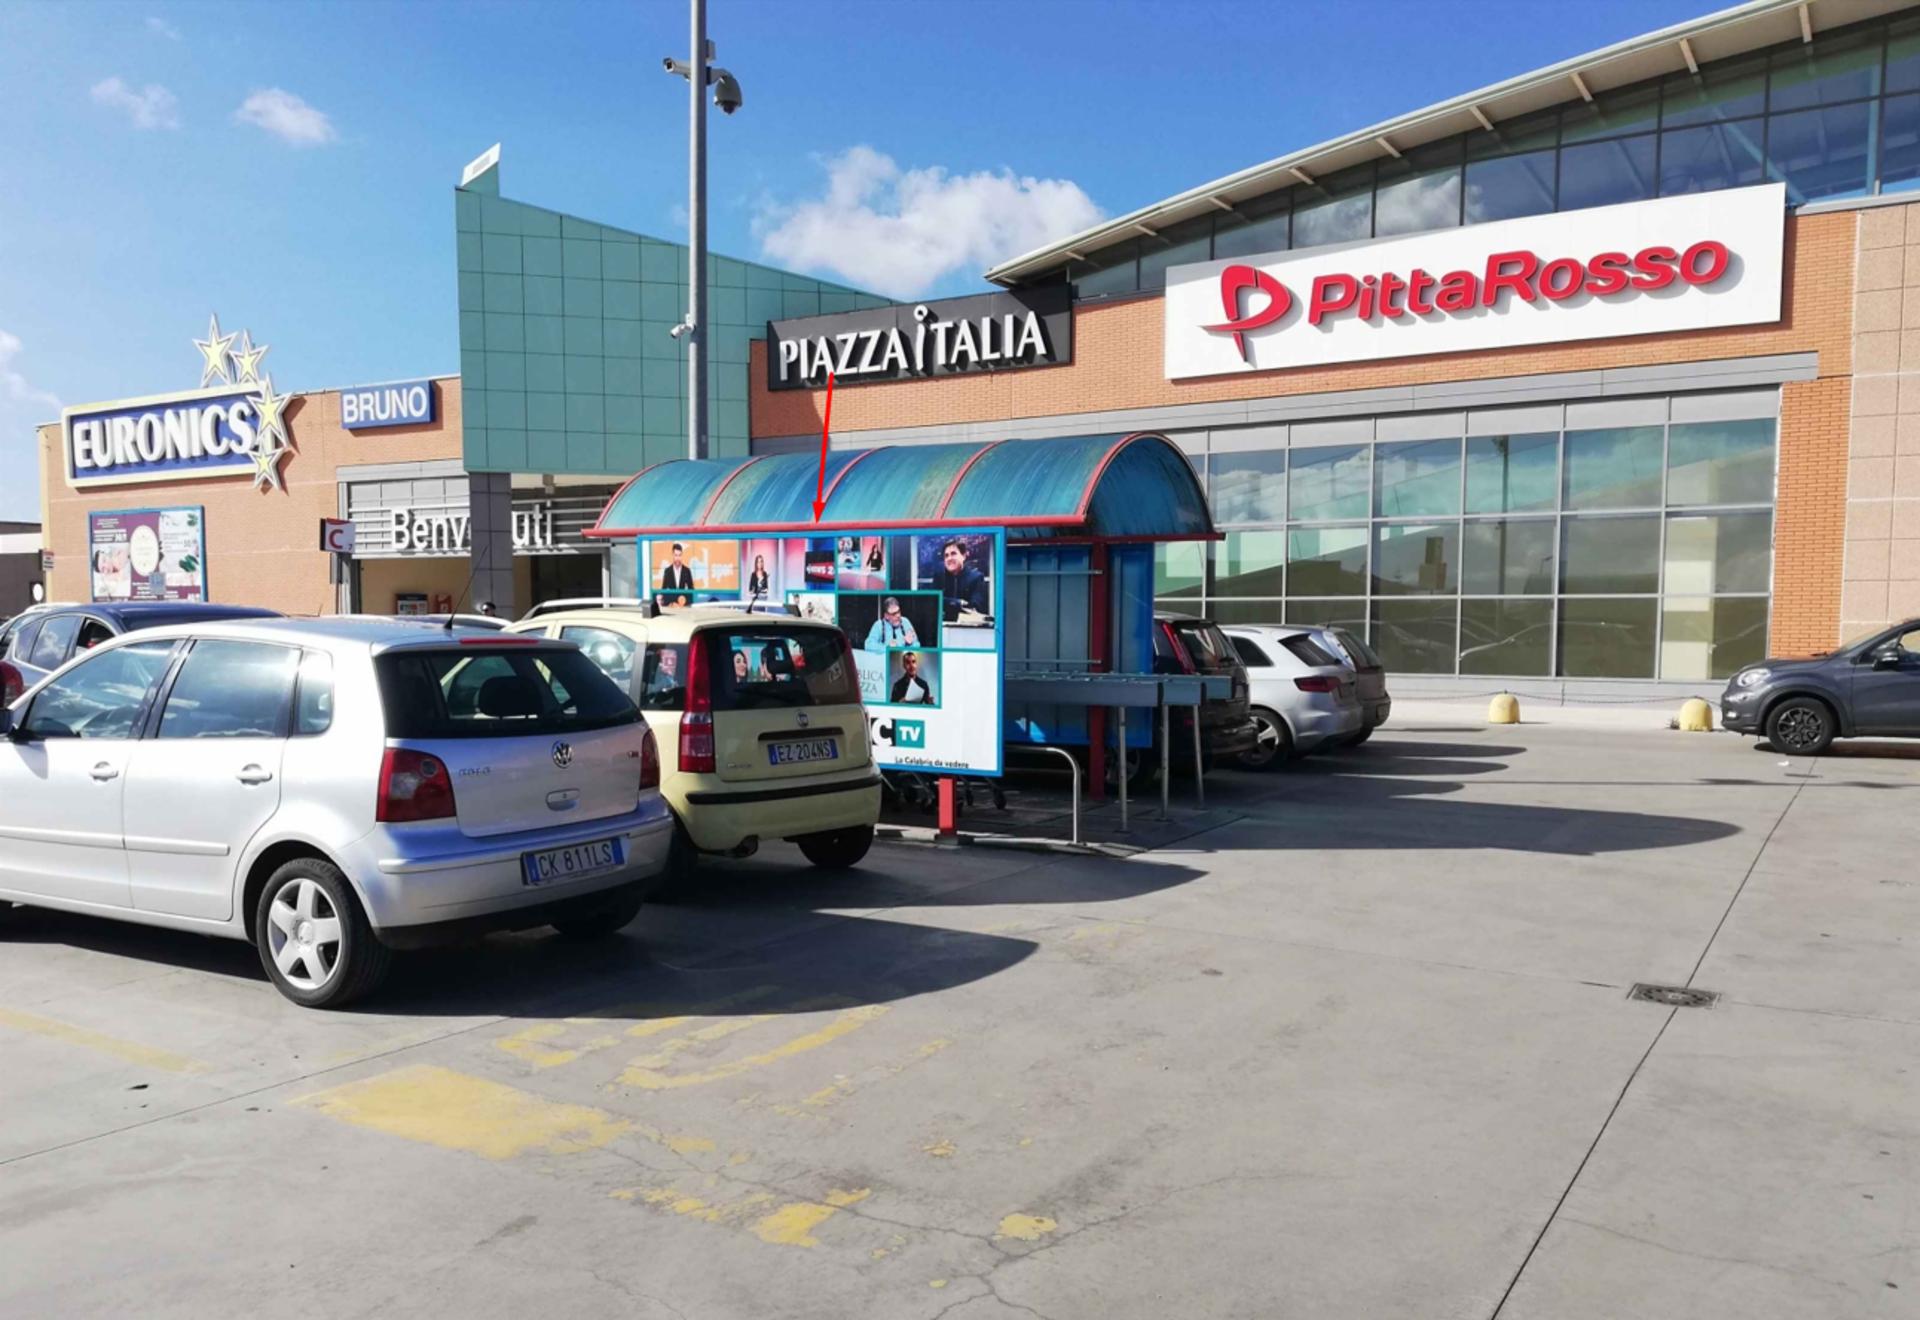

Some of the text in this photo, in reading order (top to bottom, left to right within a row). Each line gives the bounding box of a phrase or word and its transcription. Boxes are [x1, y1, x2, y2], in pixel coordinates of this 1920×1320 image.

[1308, 240, 1730, 326] PittaRosso
[779, 327, 908, 381] PIAZZA
[341, 386, 427, 423] BRUNO
[73, 401, 257, 468] EURONICS
[329, 528, 344, 550] C
[391, 502, 552, 551] Benvuti
[899, 726, 920, 742] TV
[777, 744, 793, 762] EZ
[538, 843, 613, 877] CK 811LS
